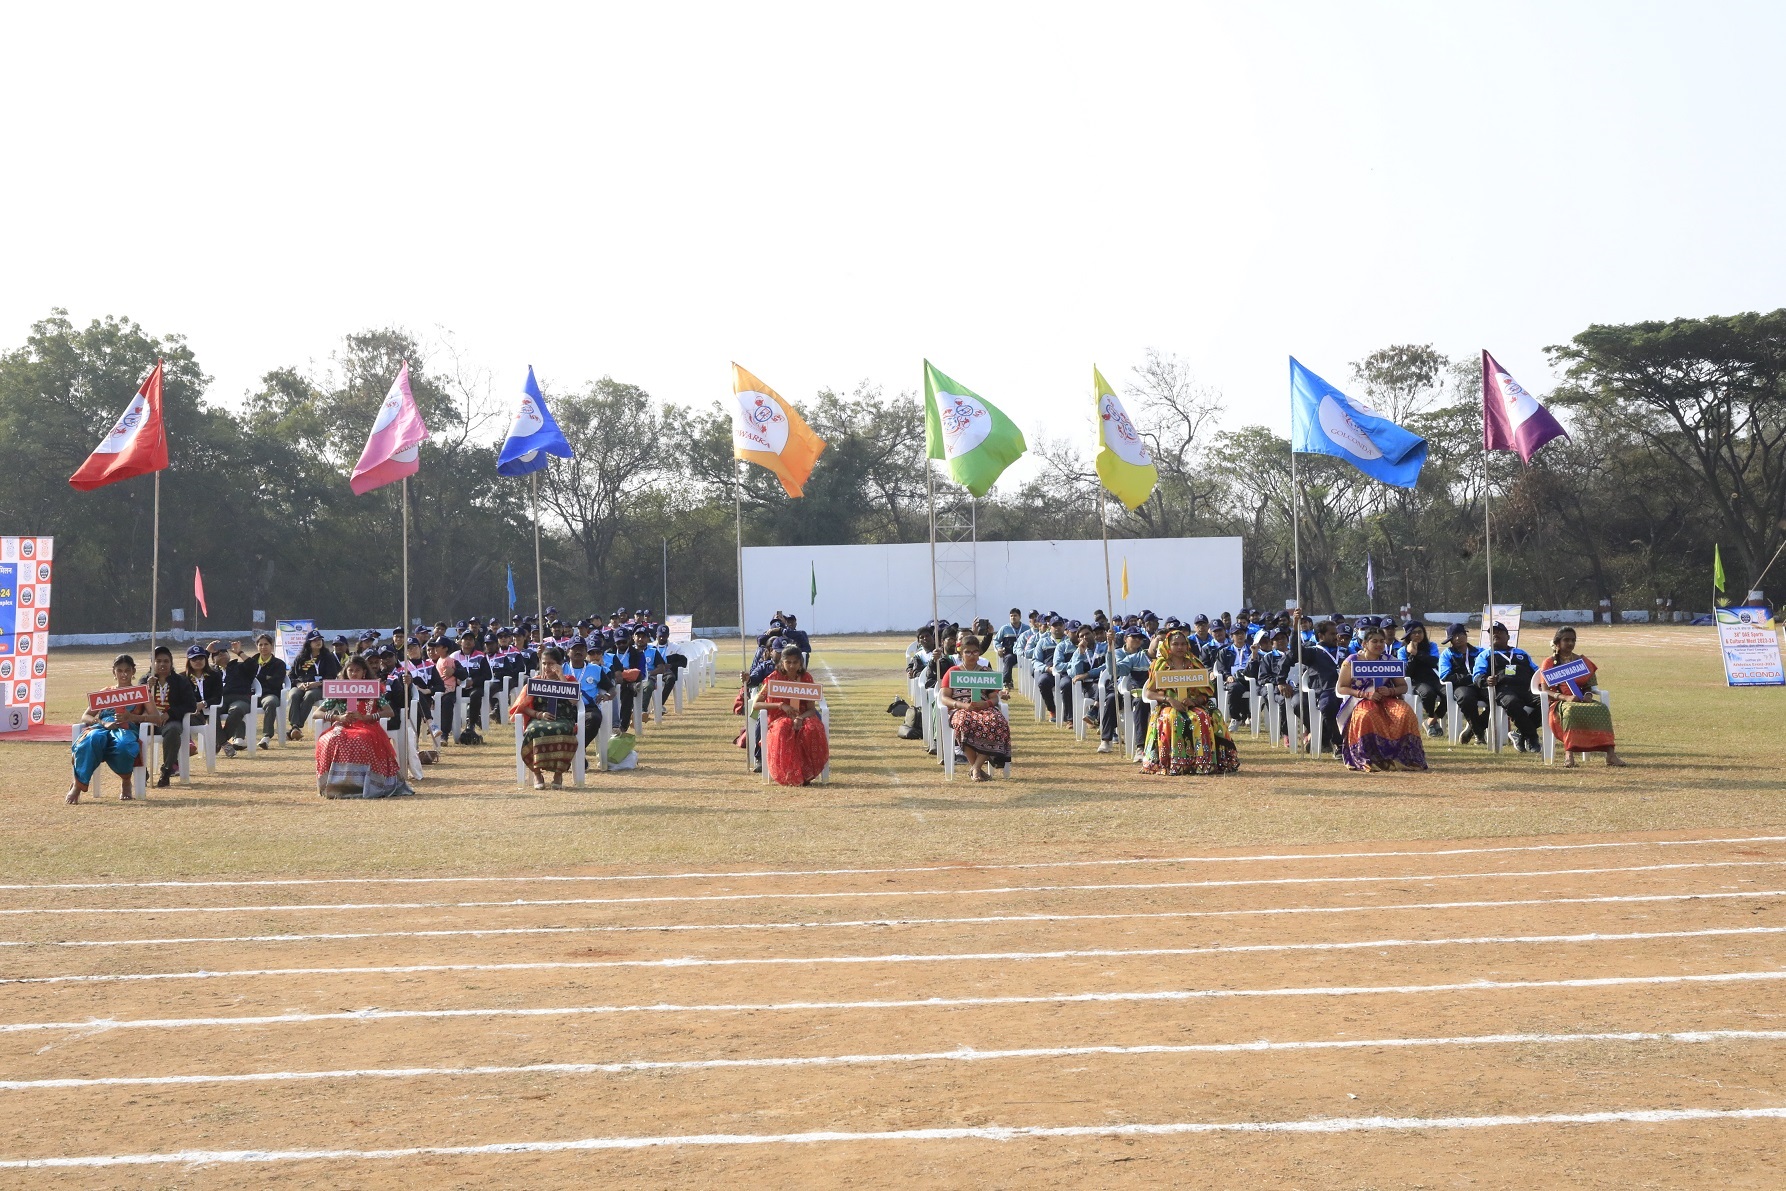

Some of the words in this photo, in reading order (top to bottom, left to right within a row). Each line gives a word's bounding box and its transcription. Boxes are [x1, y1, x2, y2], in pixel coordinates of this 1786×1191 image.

[1330, 428, 1372, 456] GOLCONDA
[1355, 665, 1402, 673] GOLCONDA
[1545, 663, 1586, 682] RAMESWARAM
[956, 675, 997, 685] KONARK
[1161, 674, 1204, 683] PUSHKAR
[328, 684, 375, 694] ELLORA
[531, 682, 577, 696] NAGARJUNA
[772, 684, 819, 696] DWARAKA
[95, 690, 144, 706] AJANTA
[12, 713, 20, 726] 3
